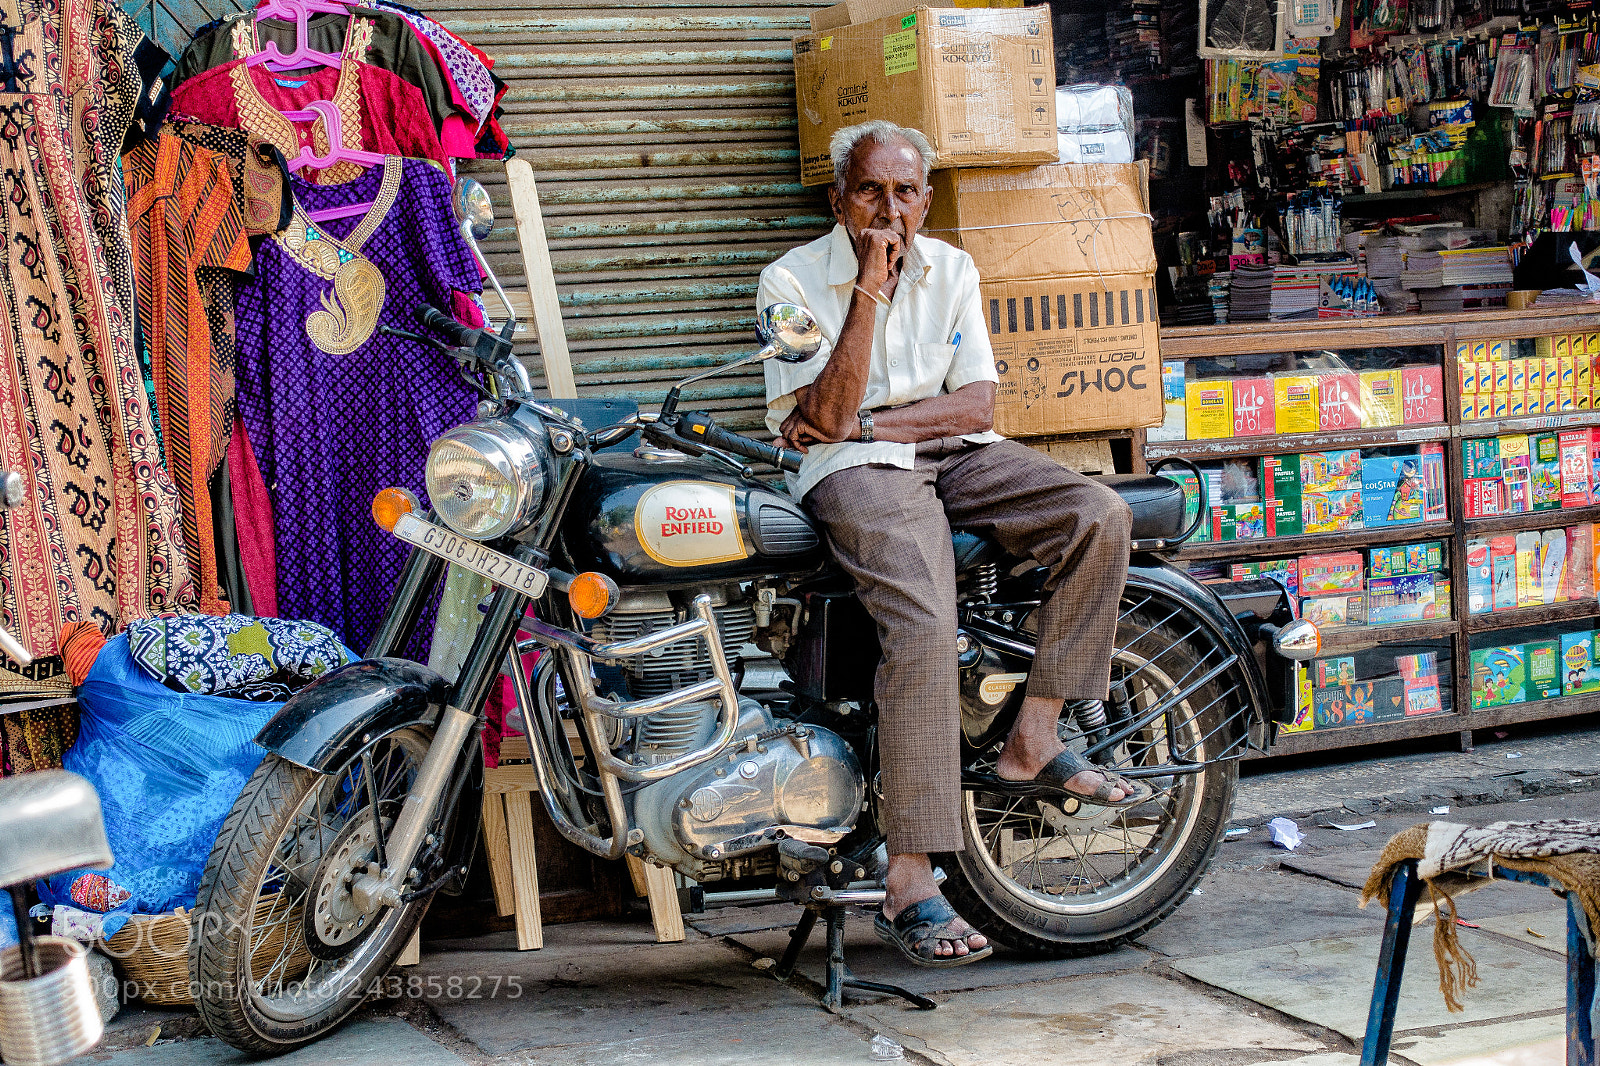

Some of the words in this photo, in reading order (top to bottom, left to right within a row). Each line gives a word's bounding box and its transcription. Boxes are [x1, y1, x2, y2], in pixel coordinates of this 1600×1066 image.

[942, 54, 992, 64] KOKUYO
[838, 95, 869, 108] KOKUYO
[1099, 350, 1146, 364] neon
[1057, 364, 1147, 398] DOMS
[1560, 433, 1587, 442] NATARAJ
[1500, 441, 1525, 450] KRUX
[1565, 456, 1585, 475] 12
[1365, 480, 1396, 491] COLSTAR
[1473, 481, 1481, 516] NATARAJ
[1483, 490, 1493, 506] 12
[1512, 489, 1524, 500] 24
[665, 506, 717, 521] ROYAL
[401, 530, 412, 538] IND
[661, 521, 724, 538] ENFIELD
[423, 527, 537, 590] GJ06JH2718
[1391, 555, 1405, 565] OIL
[1427, 551, 1440, 561] OIL
[1317, 698, 1345, 726] 68
